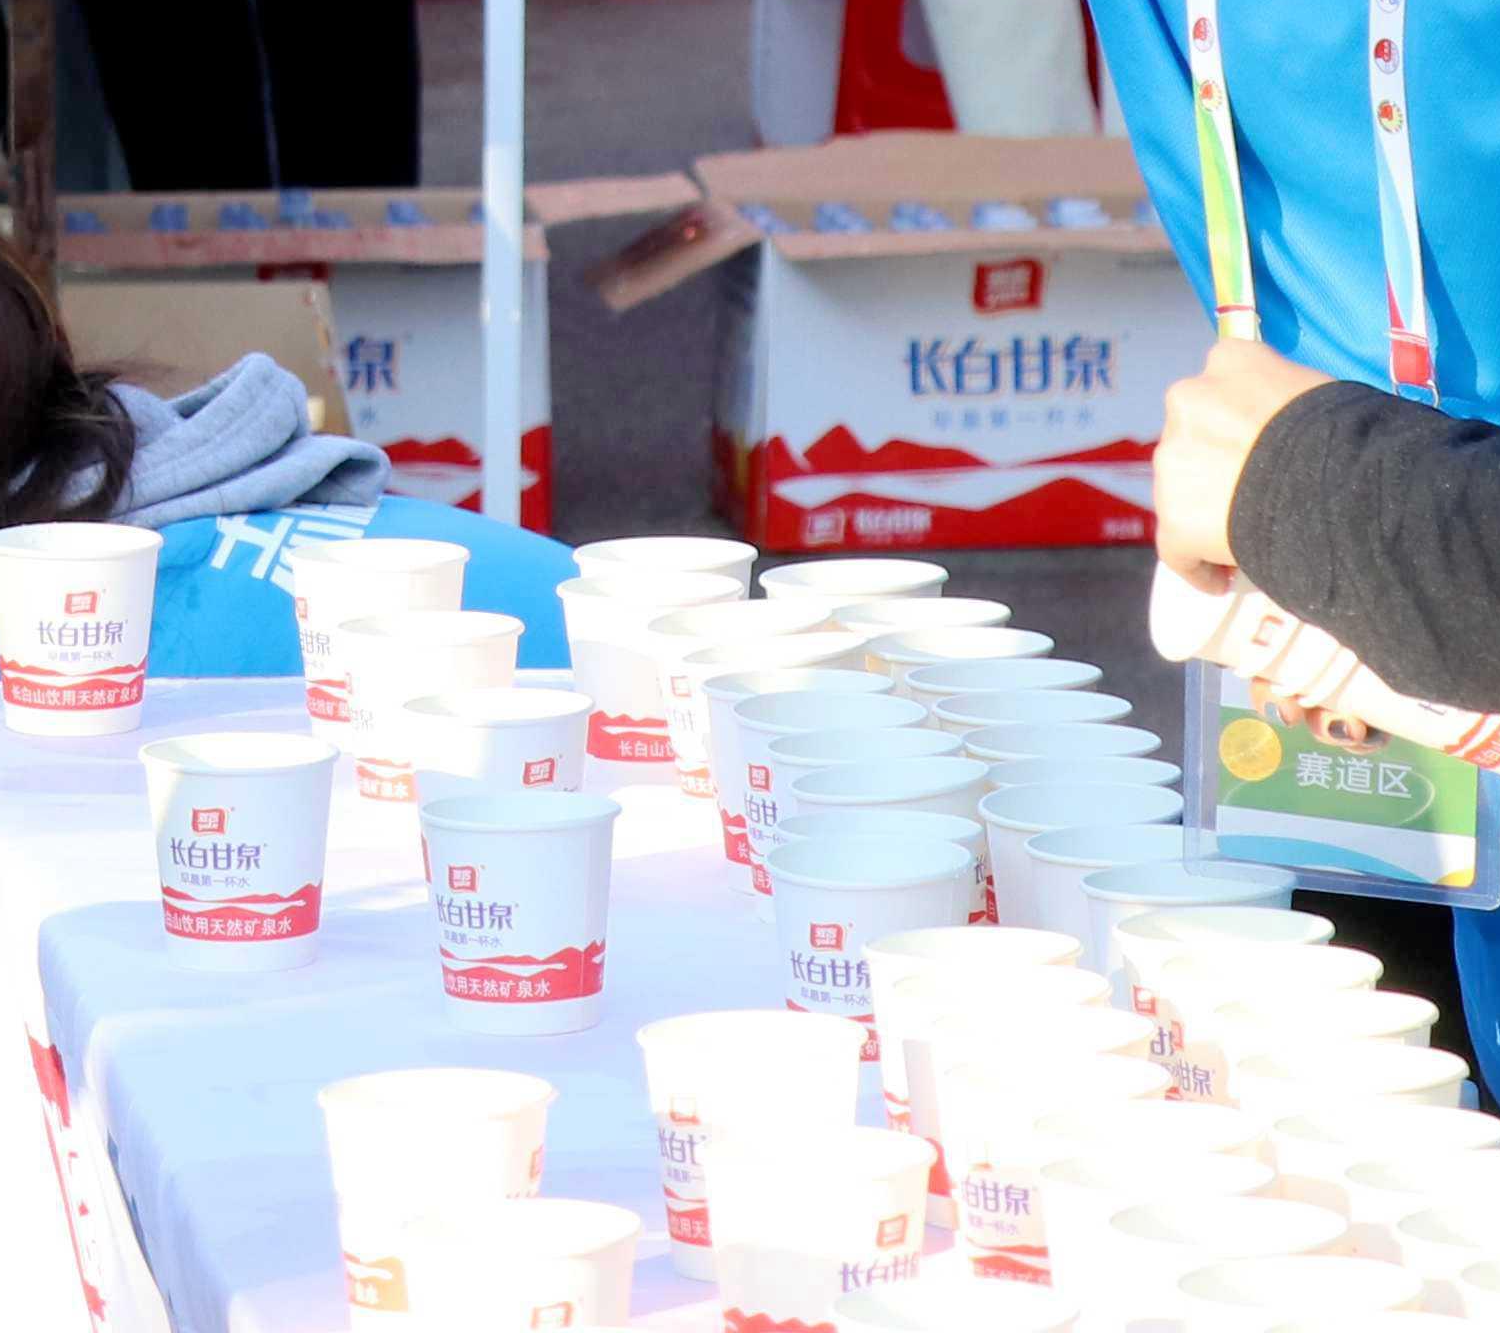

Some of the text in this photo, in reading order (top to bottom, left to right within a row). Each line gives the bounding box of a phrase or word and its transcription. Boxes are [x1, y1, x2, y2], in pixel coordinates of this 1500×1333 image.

[904, 332, 1114, 396] 长白甘泉
[36, 620, 125, 647] 长白甘泉
[10, 684, 139, 707] 长白山饮用天然矿泉水
[1295, 751, 1413, 799] 赛道区
[170, 836, 263, 871] 长白甘泉
[435, 893, 514, 931] 长白甘泉
[790, 949, 872, 989] 长白甘泉
